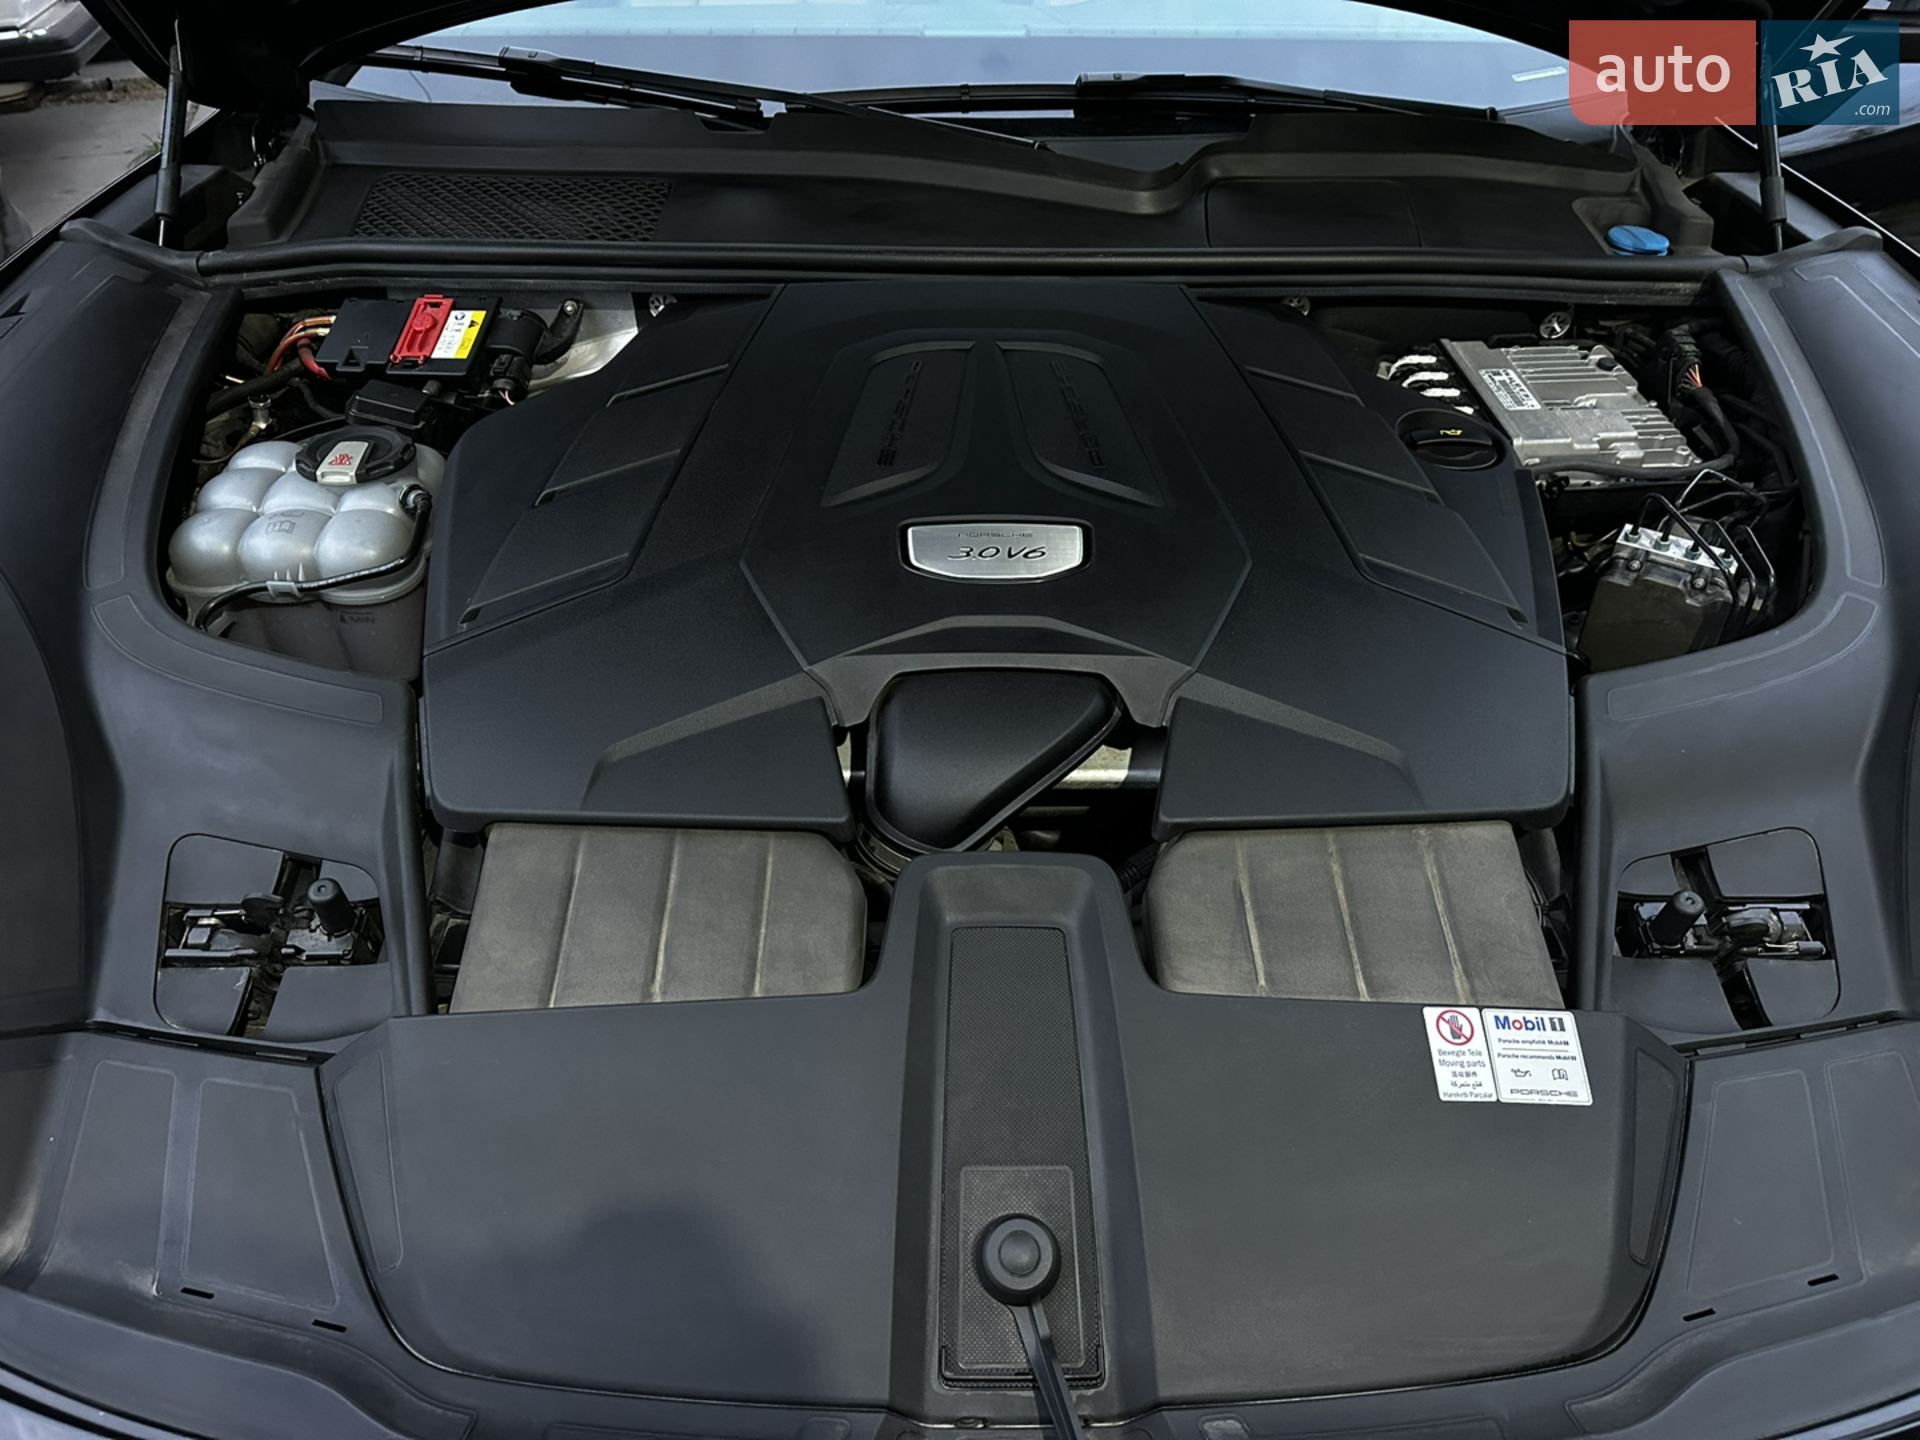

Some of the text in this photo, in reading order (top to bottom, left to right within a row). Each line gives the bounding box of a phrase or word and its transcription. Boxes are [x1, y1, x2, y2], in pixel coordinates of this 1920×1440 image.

[1494, 1015, 1546, 1031] Mobil
[1437, 1048, 1483, 1058] Bewegte Teile
[1438, 1059, 1486, 1069] Moving parts
[1510, 1088, 1579, 1098] PORSCHE
